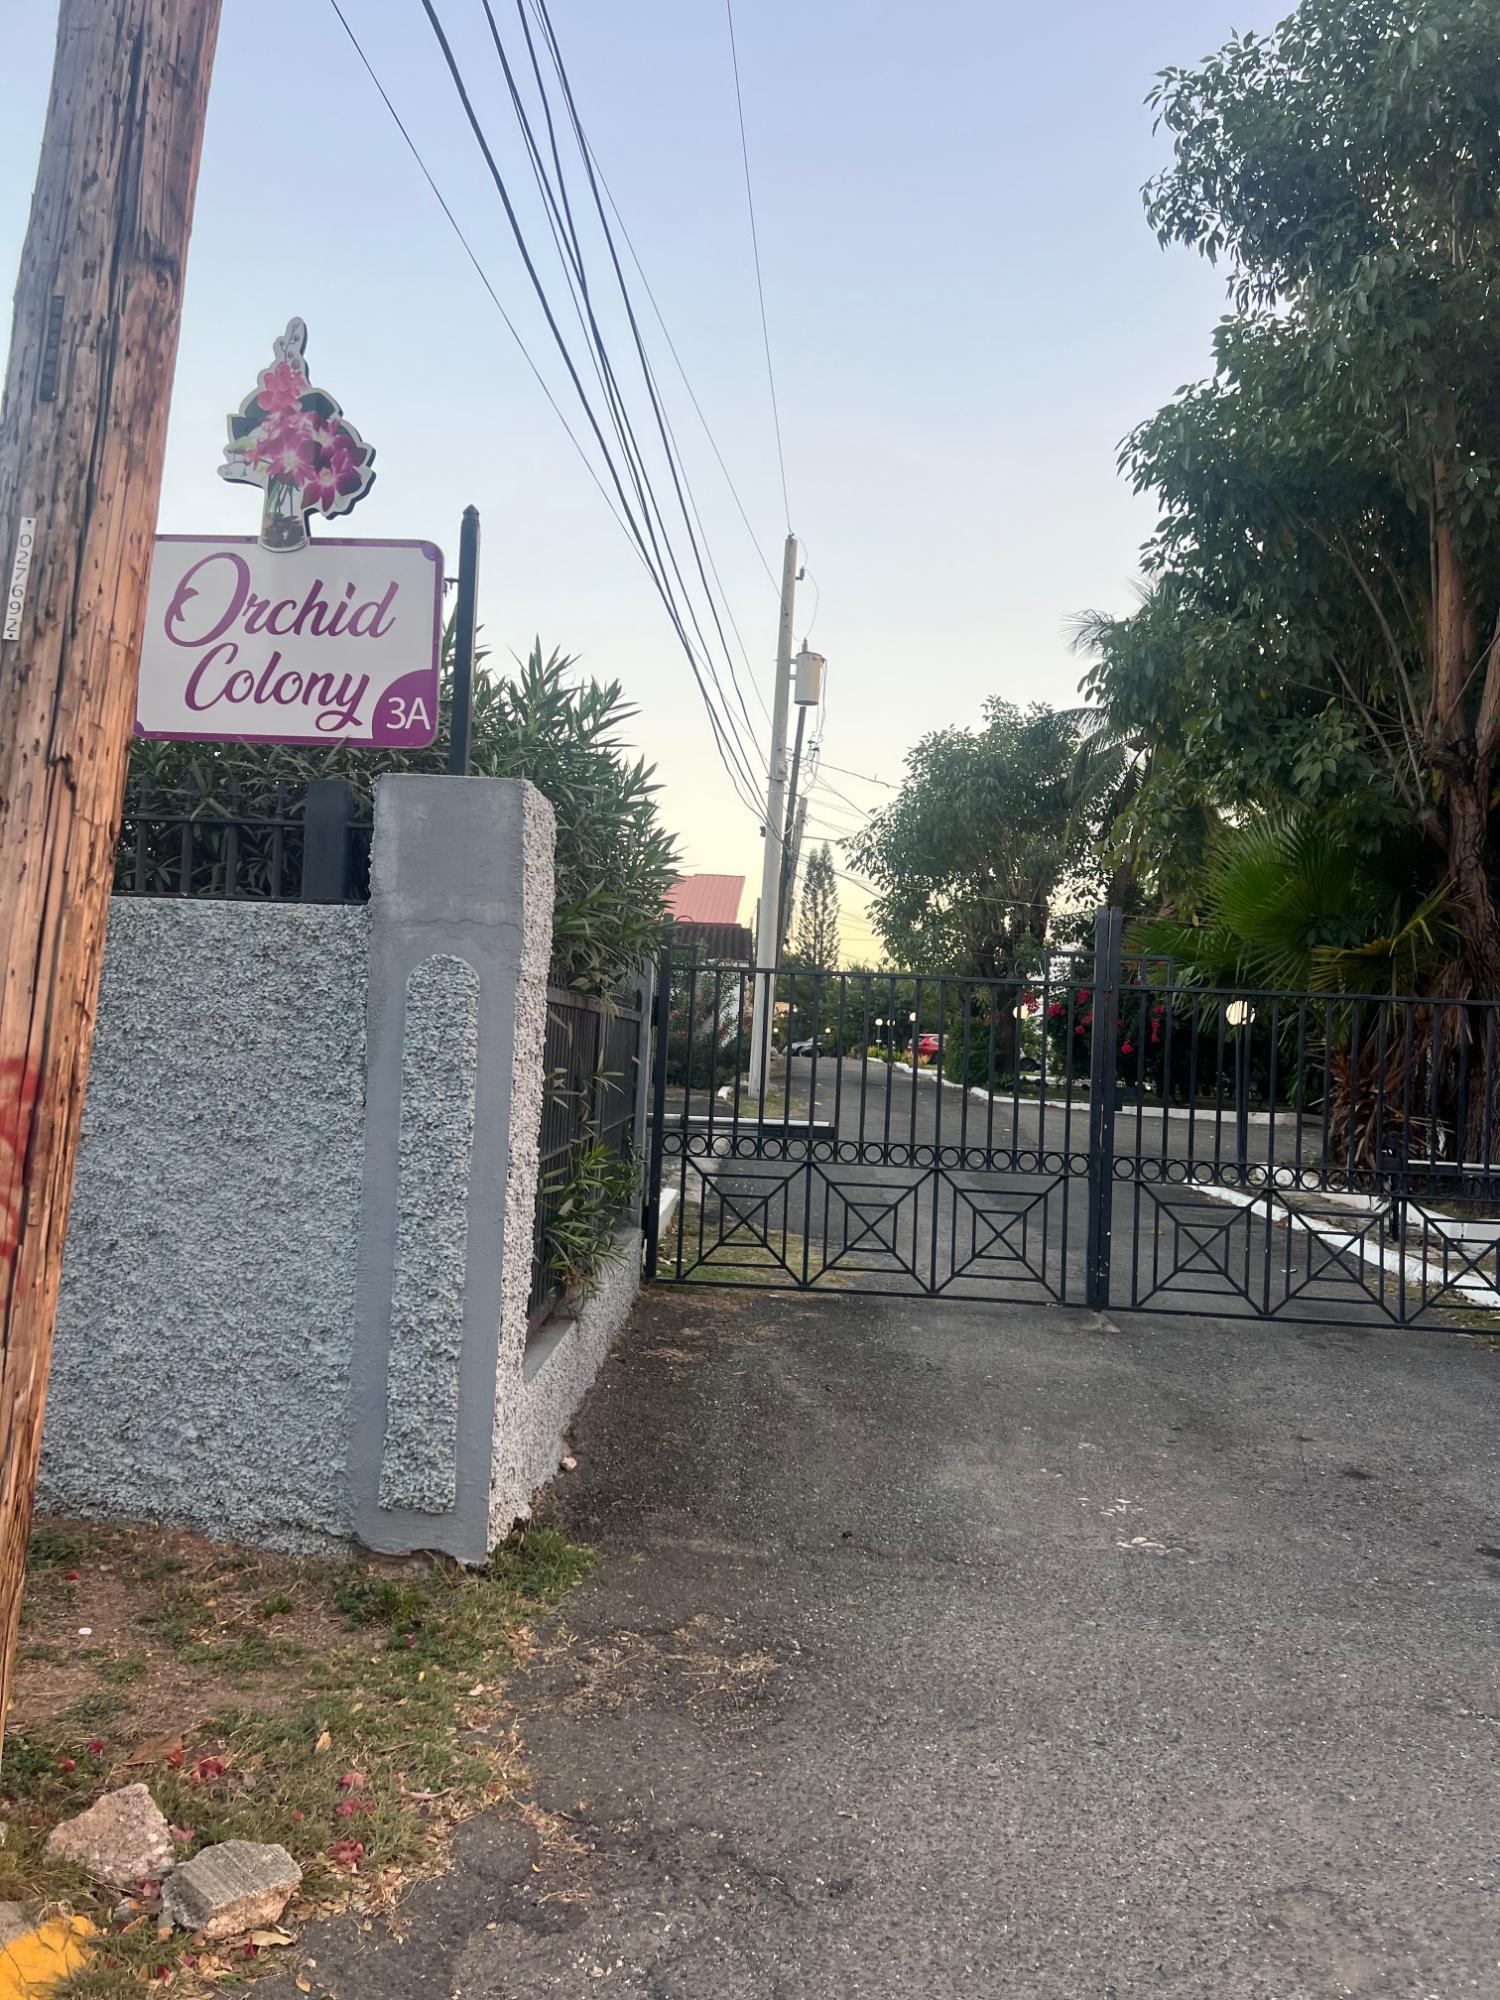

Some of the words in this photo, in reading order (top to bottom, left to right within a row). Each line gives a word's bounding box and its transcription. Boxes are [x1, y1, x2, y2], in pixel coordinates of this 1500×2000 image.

[164, 552, 399, 648] Orchid
[184, 642, 370, 732] Colony
[386, 697, 431, 731] 3A
